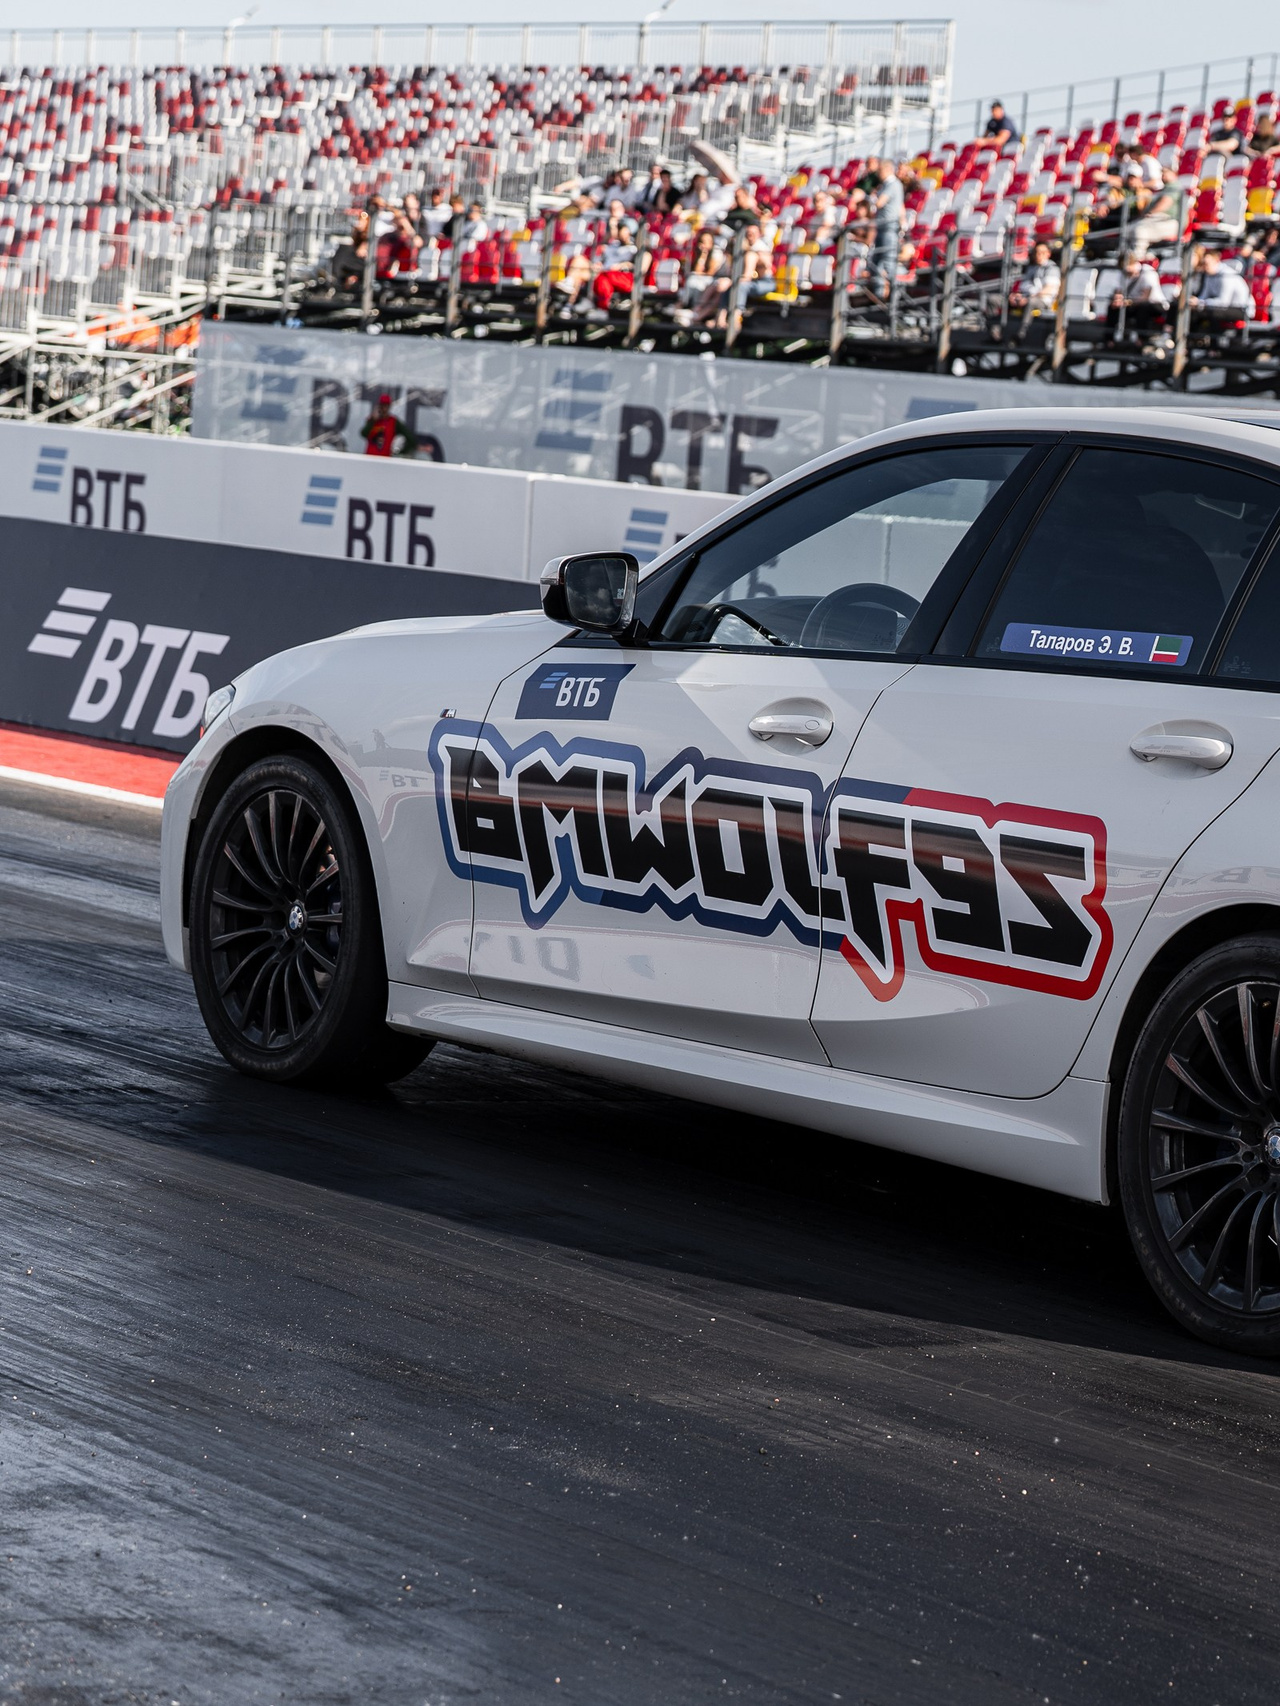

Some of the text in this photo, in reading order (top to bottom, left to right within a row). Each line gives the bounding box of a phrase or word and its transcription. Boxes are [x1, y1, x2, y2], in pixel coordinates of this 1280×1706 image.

[70, 466, 147, 533] ВТБ
[346, 497, 436, 567] ВТБ
[1029, 629, 1134, 656] Таларов Э. В.
[68, 618, 231, 738] ВТБ
[555, 677, 606, 707] ВТБ
